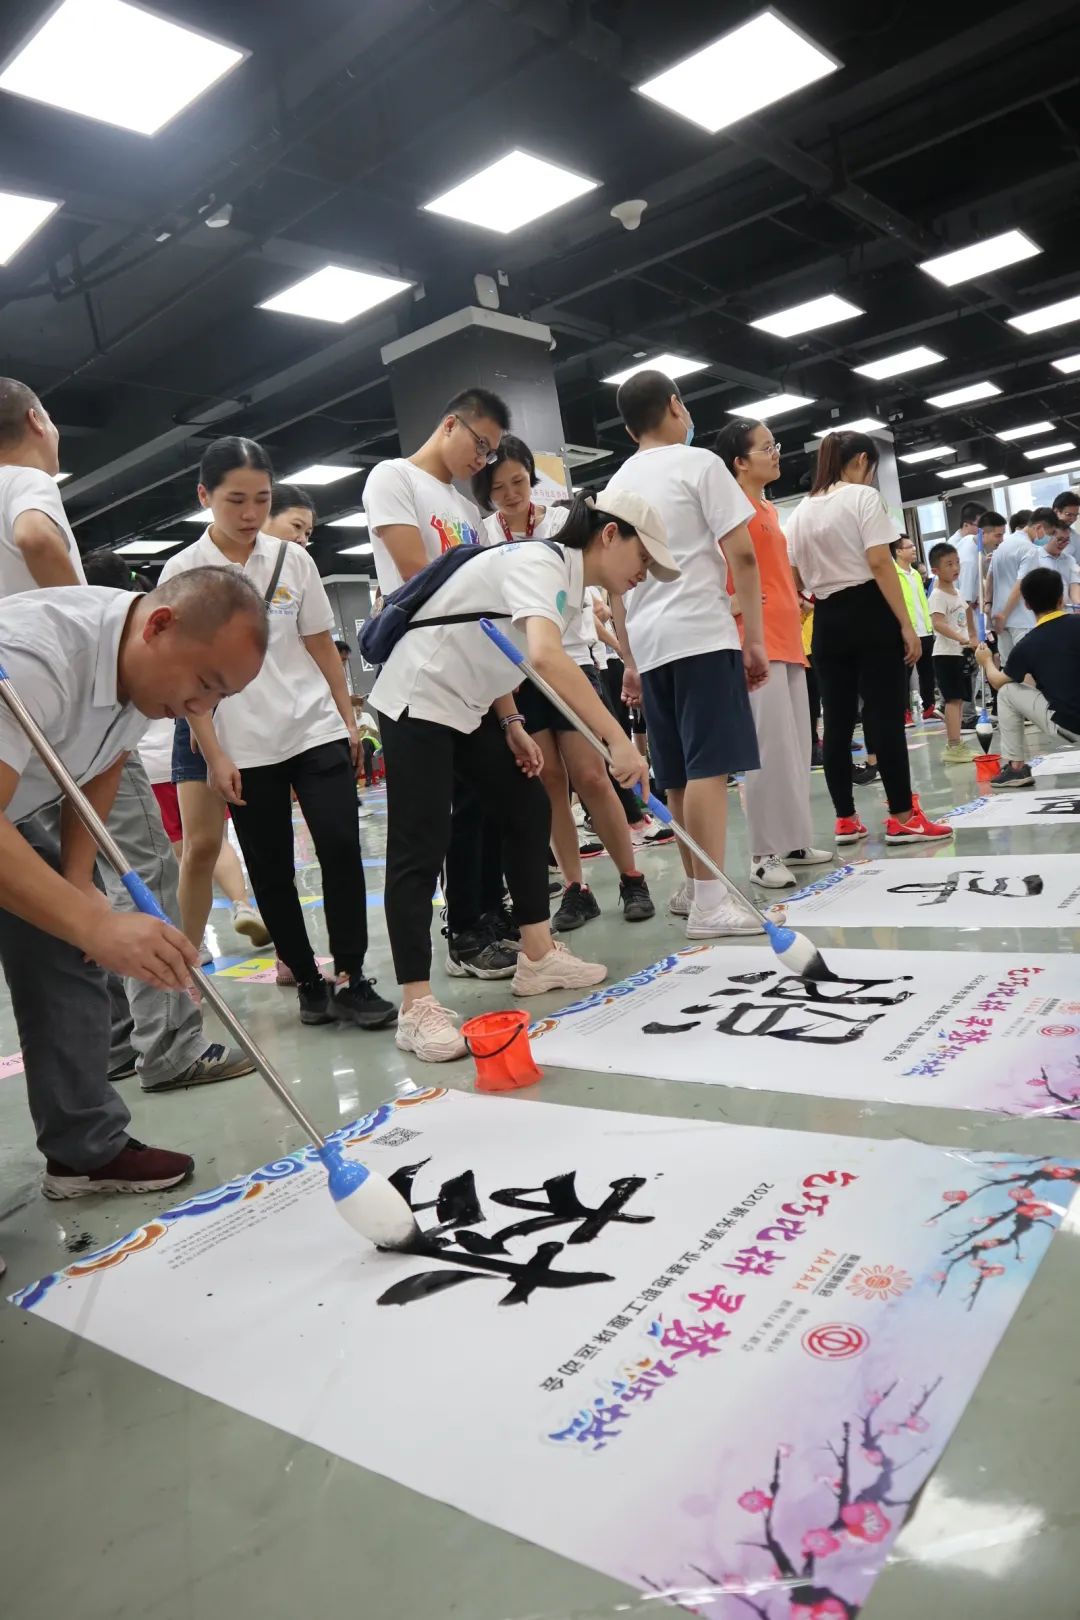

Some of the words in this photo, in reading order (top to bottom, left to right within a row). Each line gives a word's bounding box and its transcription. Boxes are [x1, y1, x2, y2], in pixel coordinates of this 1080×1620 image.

[539, 1182, 775, 1392] 2020新光源产业基地职工趣味运动会
[720, 1170, 860, 1276] 乞巧比拼
